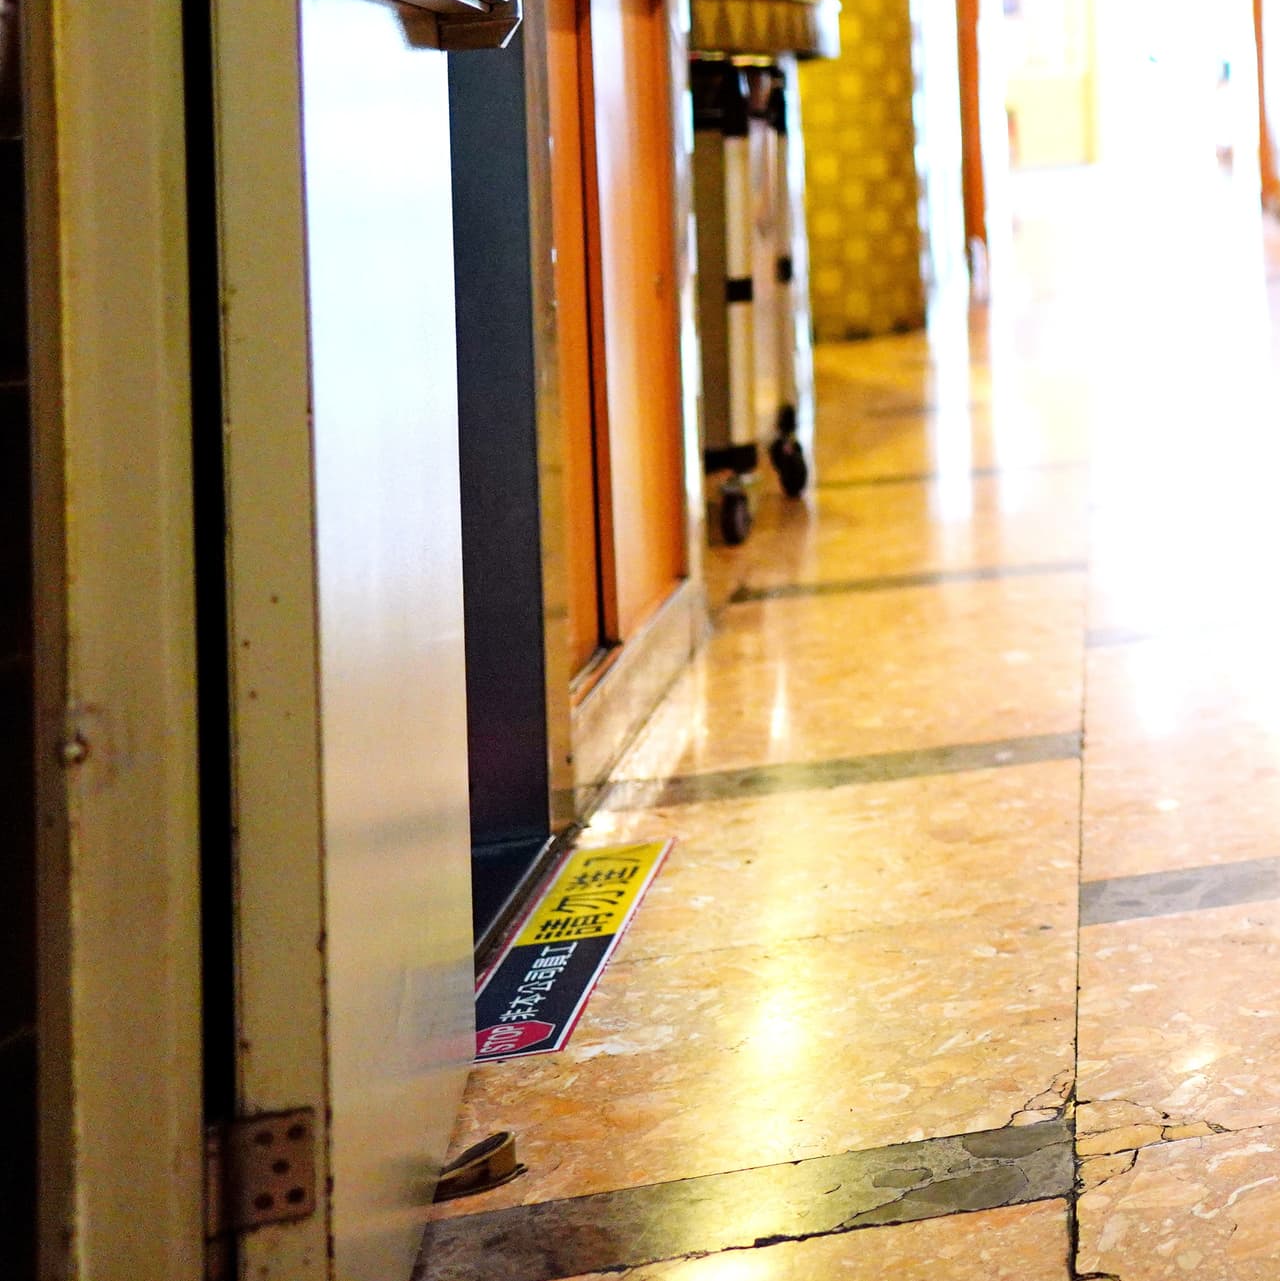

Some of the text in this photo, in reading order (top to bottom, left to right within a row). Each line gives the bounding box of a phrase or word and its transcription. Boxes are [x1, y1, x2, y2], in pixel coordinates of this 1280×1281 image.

[536, 844, 652, 940] 請勿進入
[499, 942, 578, 1022] 非本公司員工
[480, 1024, 524, 1054] STOP
